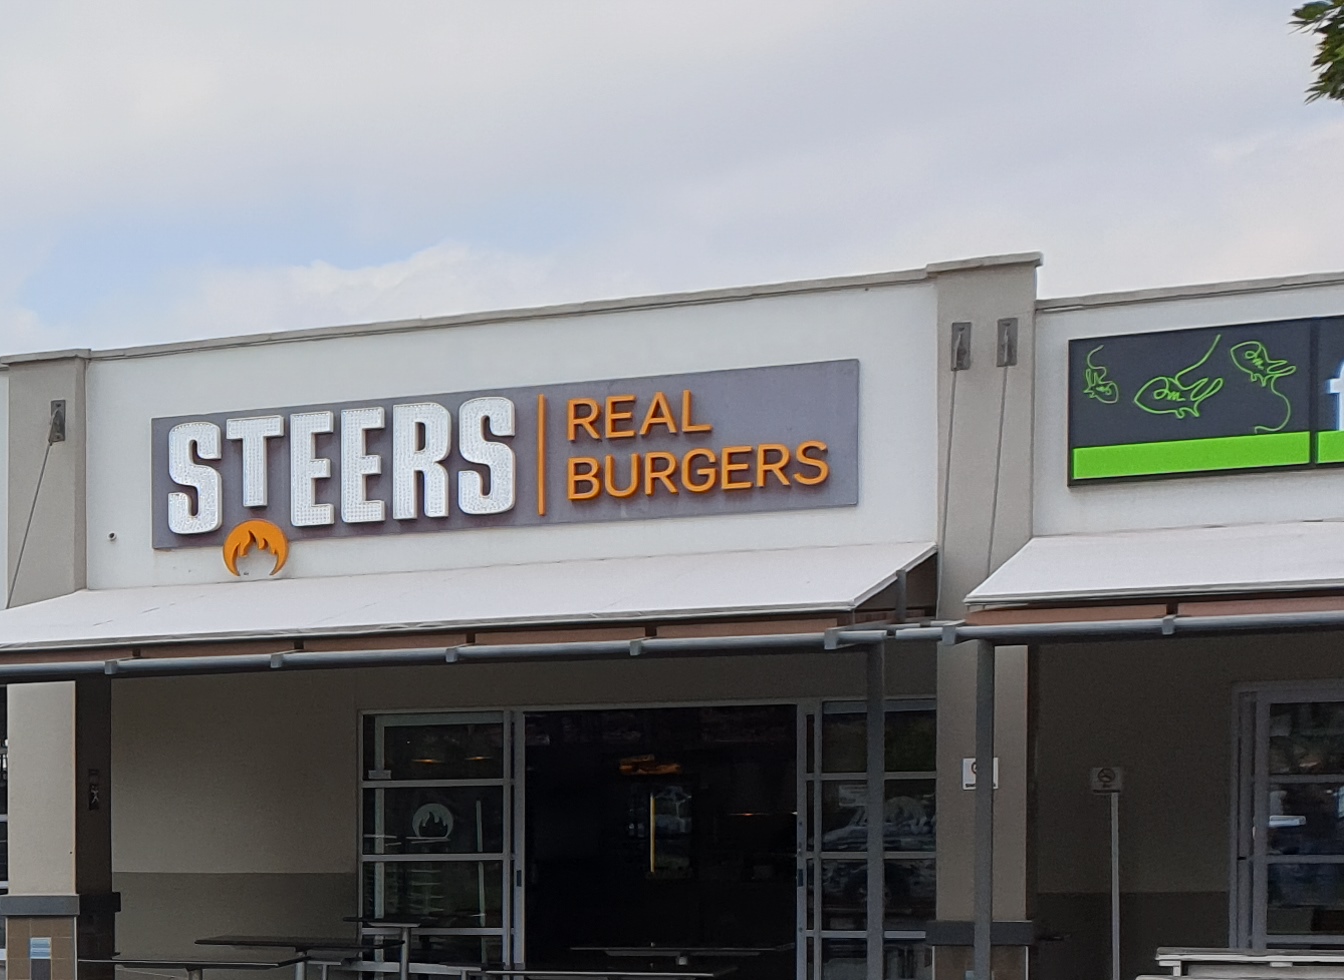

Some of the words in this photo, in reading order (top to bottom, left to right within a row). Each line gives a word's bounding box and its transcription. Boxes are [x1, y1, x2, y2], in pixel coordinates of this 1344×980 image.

[567, 390, 712, 442] REAL
[168, 397, 516, 535] STEERS
[567, 440, 830, 501] BURGERS
